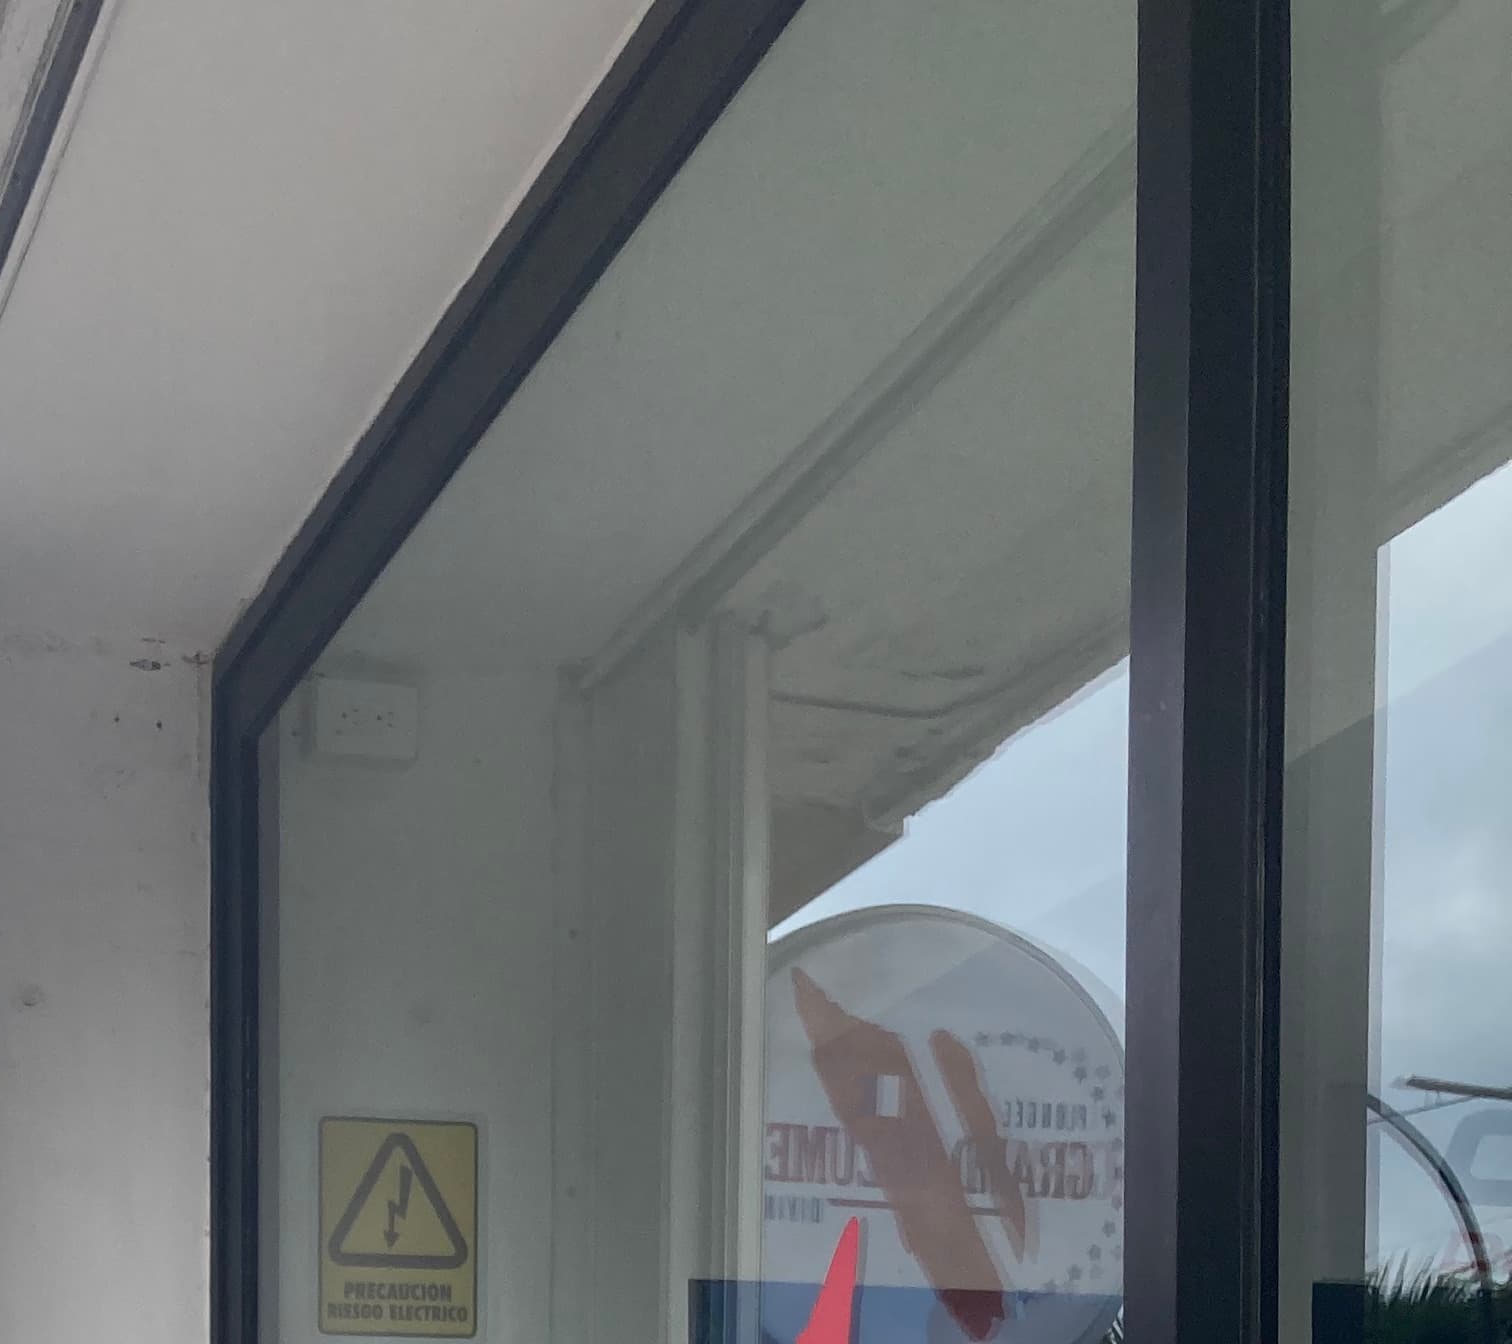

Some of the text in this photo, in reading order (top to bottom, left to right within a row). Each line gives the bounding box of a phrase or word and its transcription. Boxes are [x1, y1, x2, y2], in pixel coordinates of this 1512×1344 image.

[344, 1281, 452, 1302] PRECAUCION
[327, 1303, 468, 1322] RIESGO ELECTRICO
